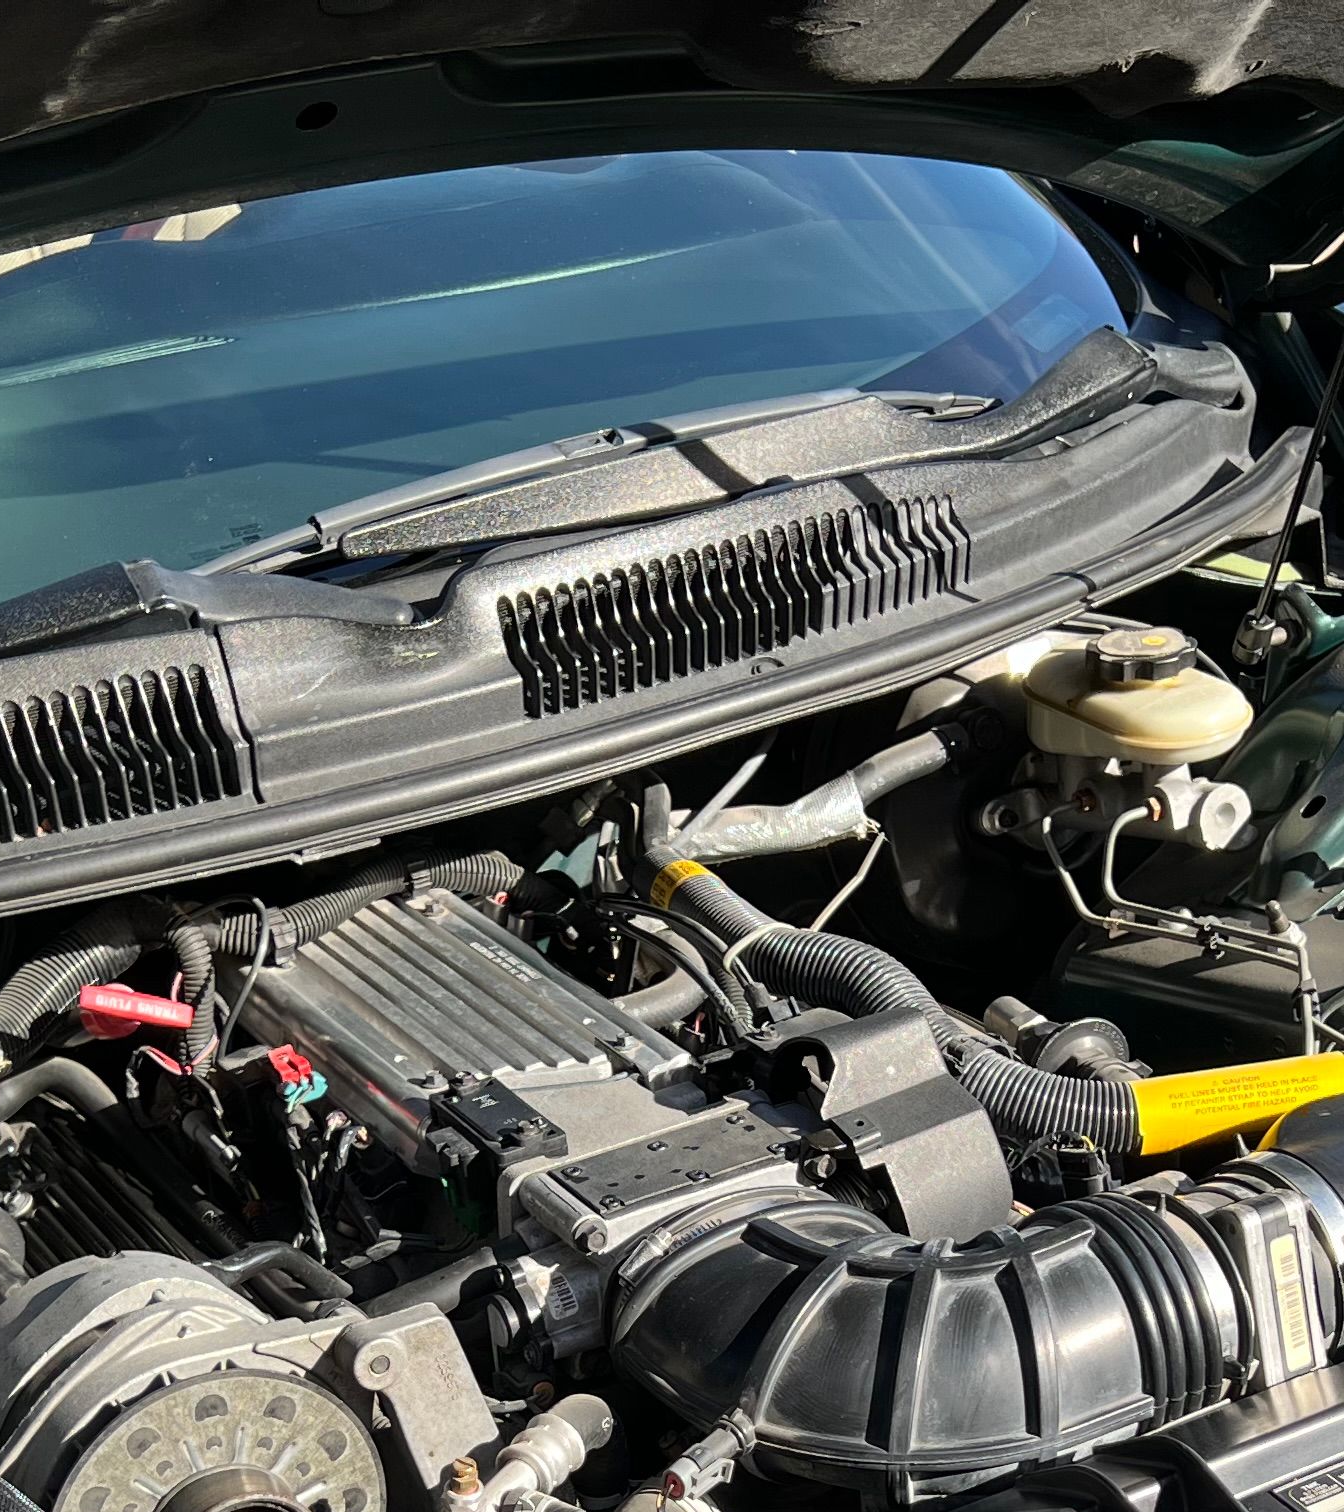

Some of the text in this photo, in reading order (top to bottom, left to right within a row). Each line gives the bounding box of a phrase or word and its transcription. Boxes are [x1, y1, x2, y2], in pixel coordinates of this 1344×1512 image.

[96, 994, 177, 1019] TRANS FLUID
[1169, 1092, 1190, 1100] FUEL
[1192, 1088, 1216, 1097] LINES
[1218, 1085, 1240, 1094] MUST
[1243, 1083, 1254, 1091] BE
[1256, 1081, 1277, 1089] HELD
[1291, 1075, 1318, 1084] PLACE
[1223, 1076, 1260, 1085] CAUTION
[1171, 1084, 1318, 1109] BY RETAINER STRAP TO HELP AVOID
[1195, 1097, 1297, 1115] POTENTIAL FIRE HAZARD
